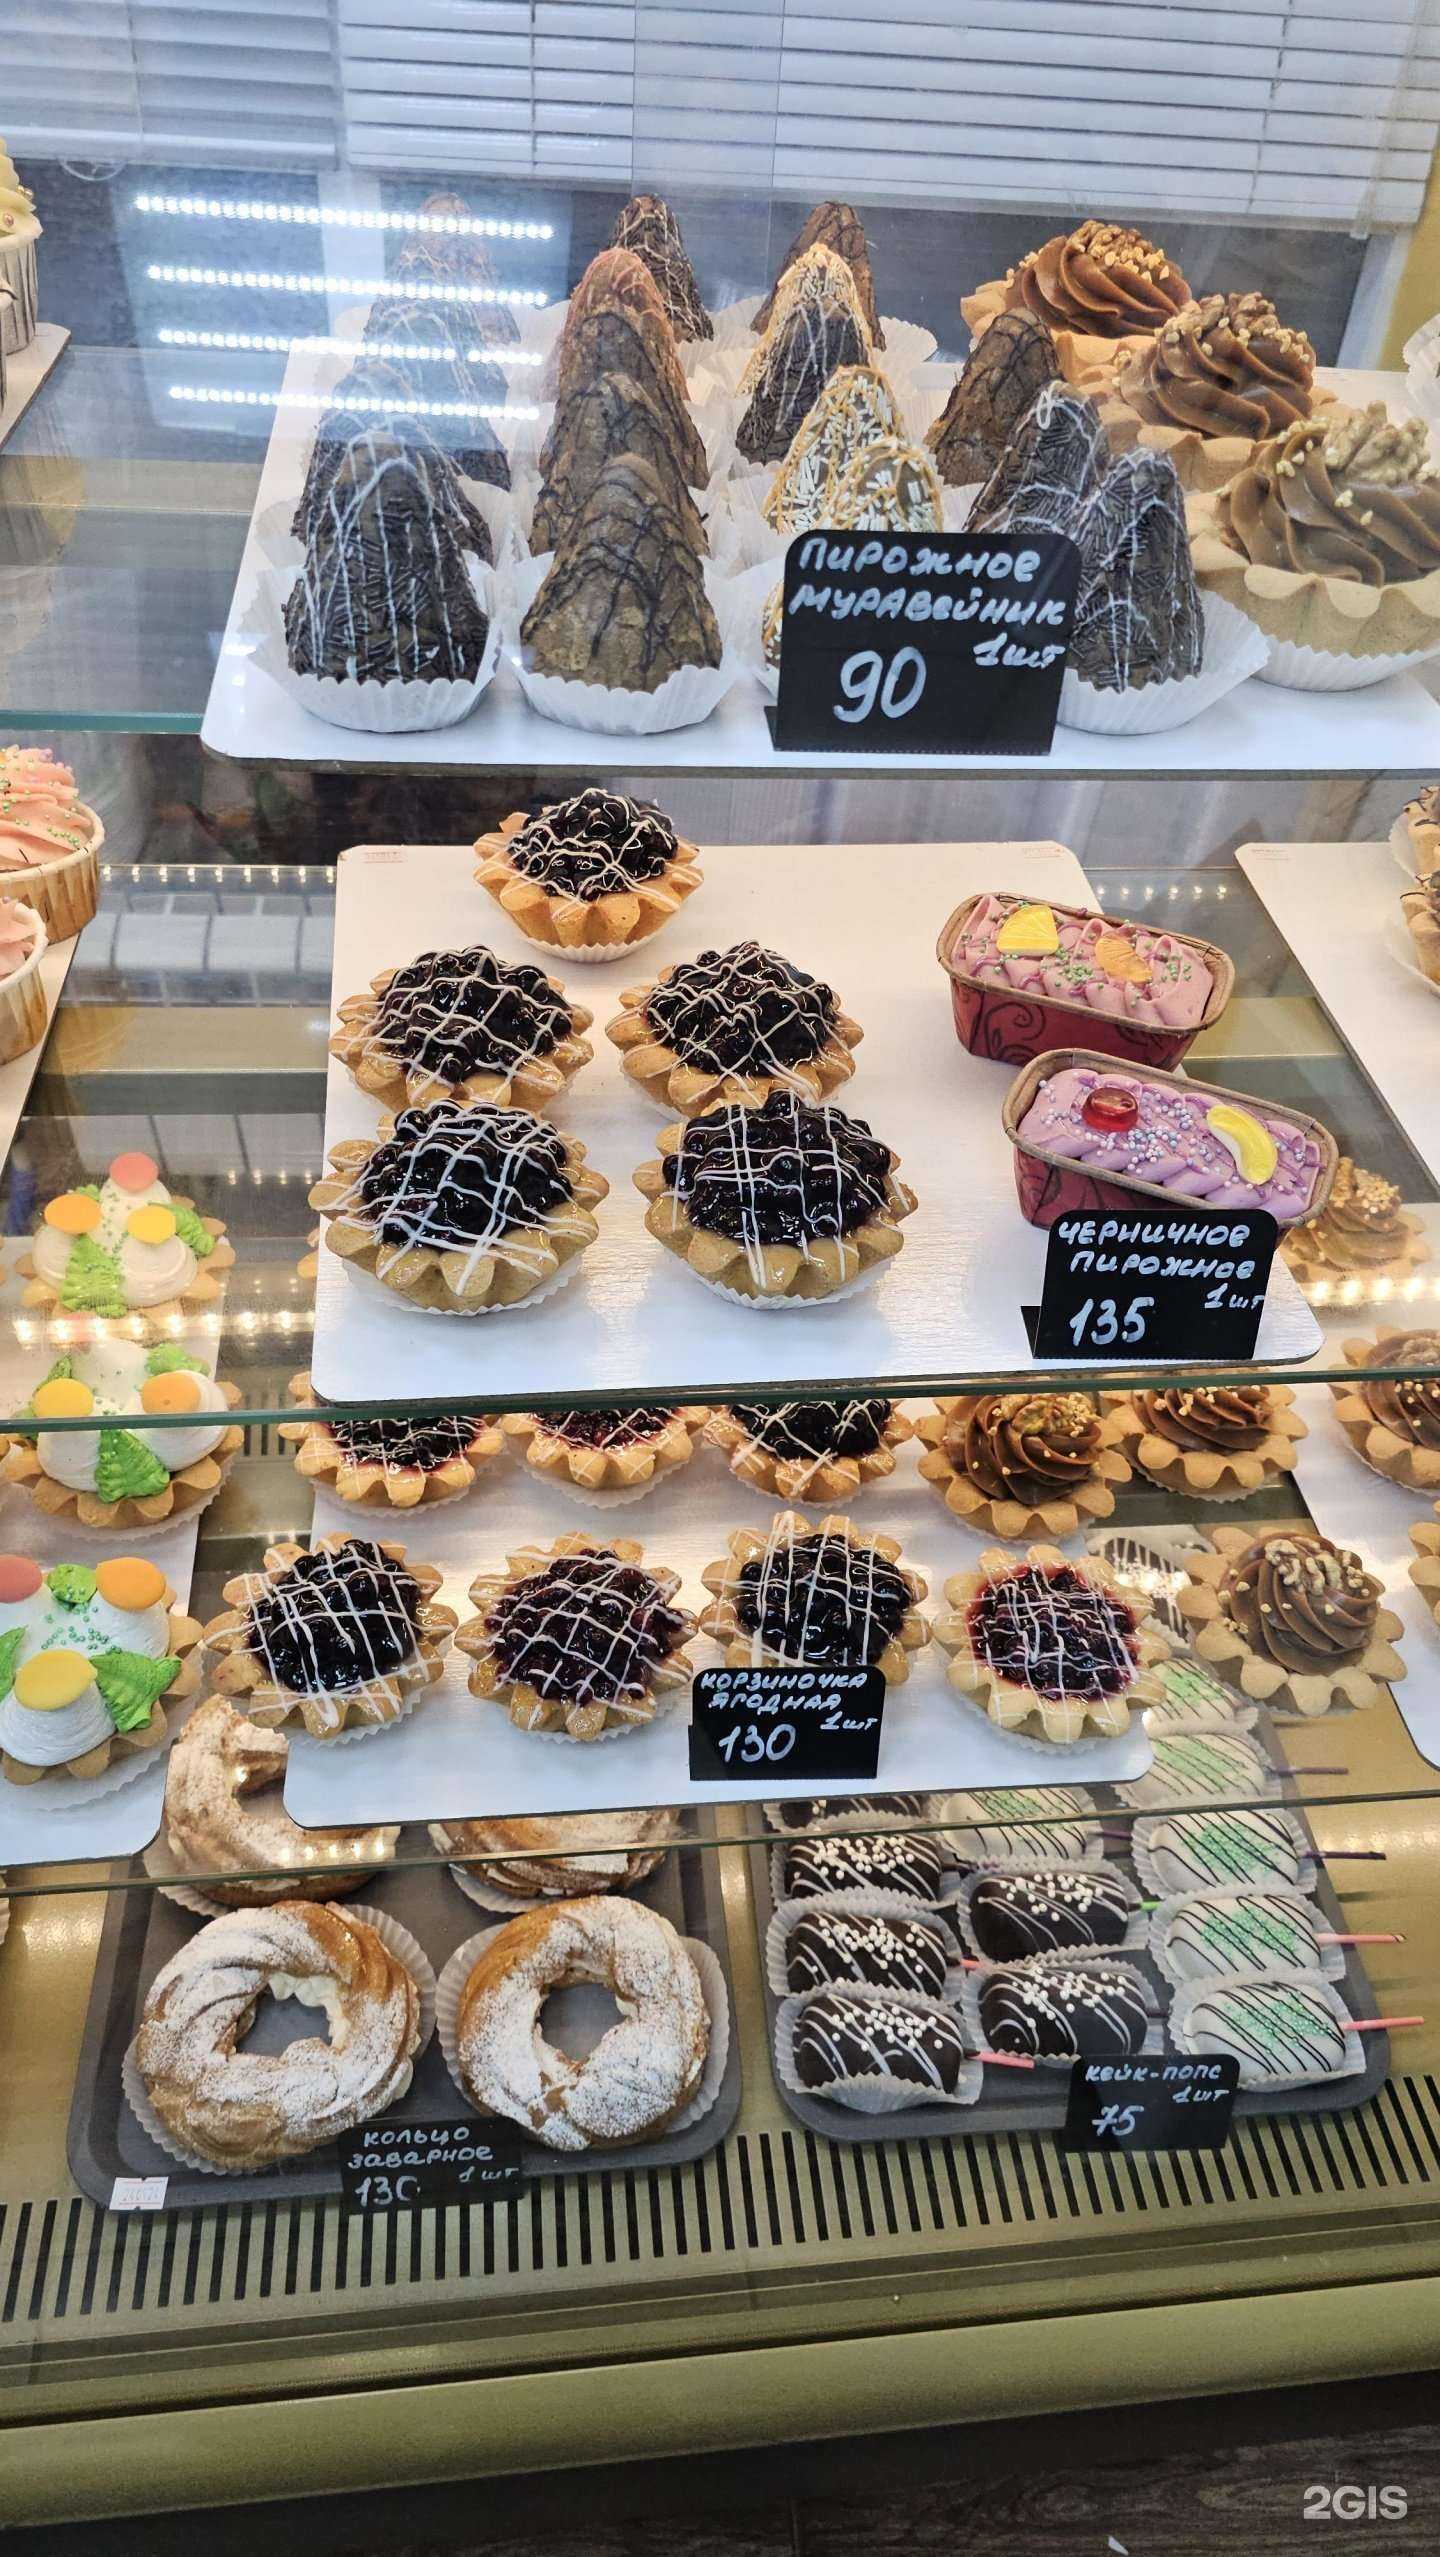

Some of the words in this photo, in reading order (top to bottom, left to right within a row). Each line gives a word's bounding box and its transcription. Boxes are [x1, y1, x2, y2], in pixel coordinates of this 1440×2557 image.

[833, 646, 927, 724] 90
[1069, 1296, 1155, 1347] 135
[718, 1723, 797, 1763] 130
[1091, 2103, 1145, 2137] 75
